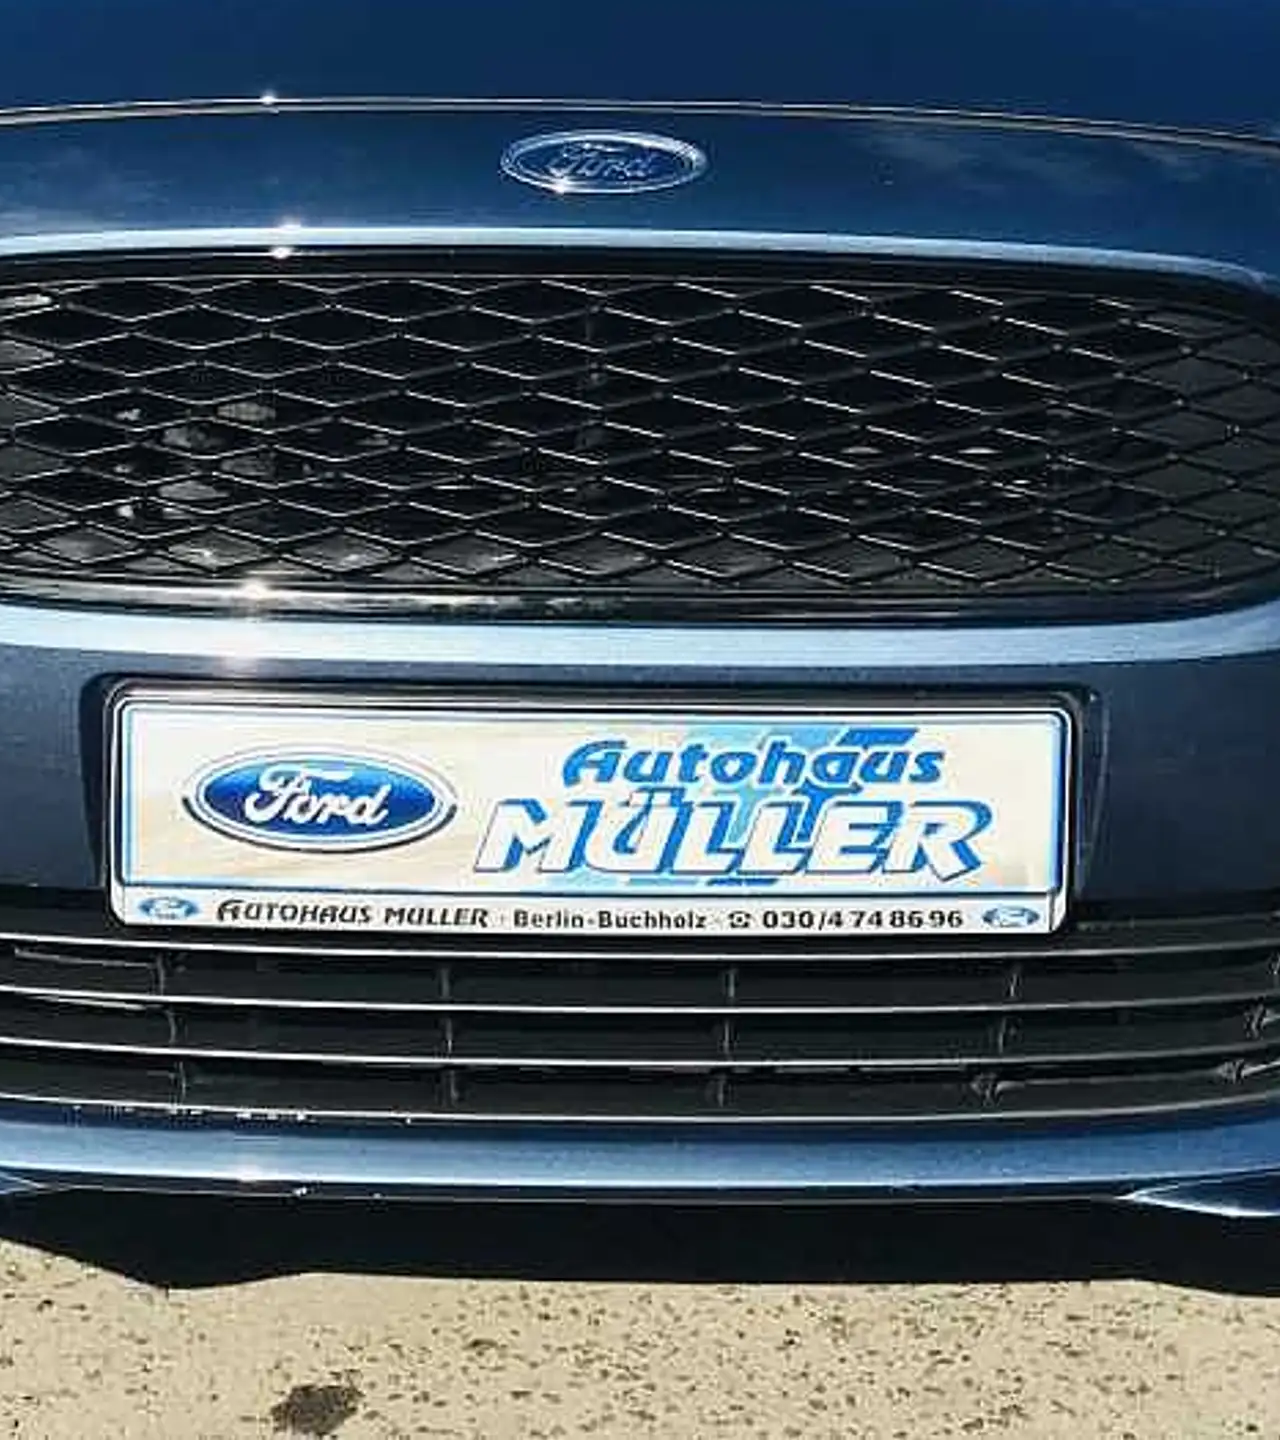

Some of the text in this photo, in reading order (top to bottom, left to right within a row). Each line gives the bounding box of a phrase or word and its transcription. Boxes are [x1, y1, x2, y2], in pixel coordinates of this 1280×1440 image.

[562, 736, 947, 786] Autohaus
[245, 765, 391, 826] Ford
[473, 796, 994, 881] MÜLLER
